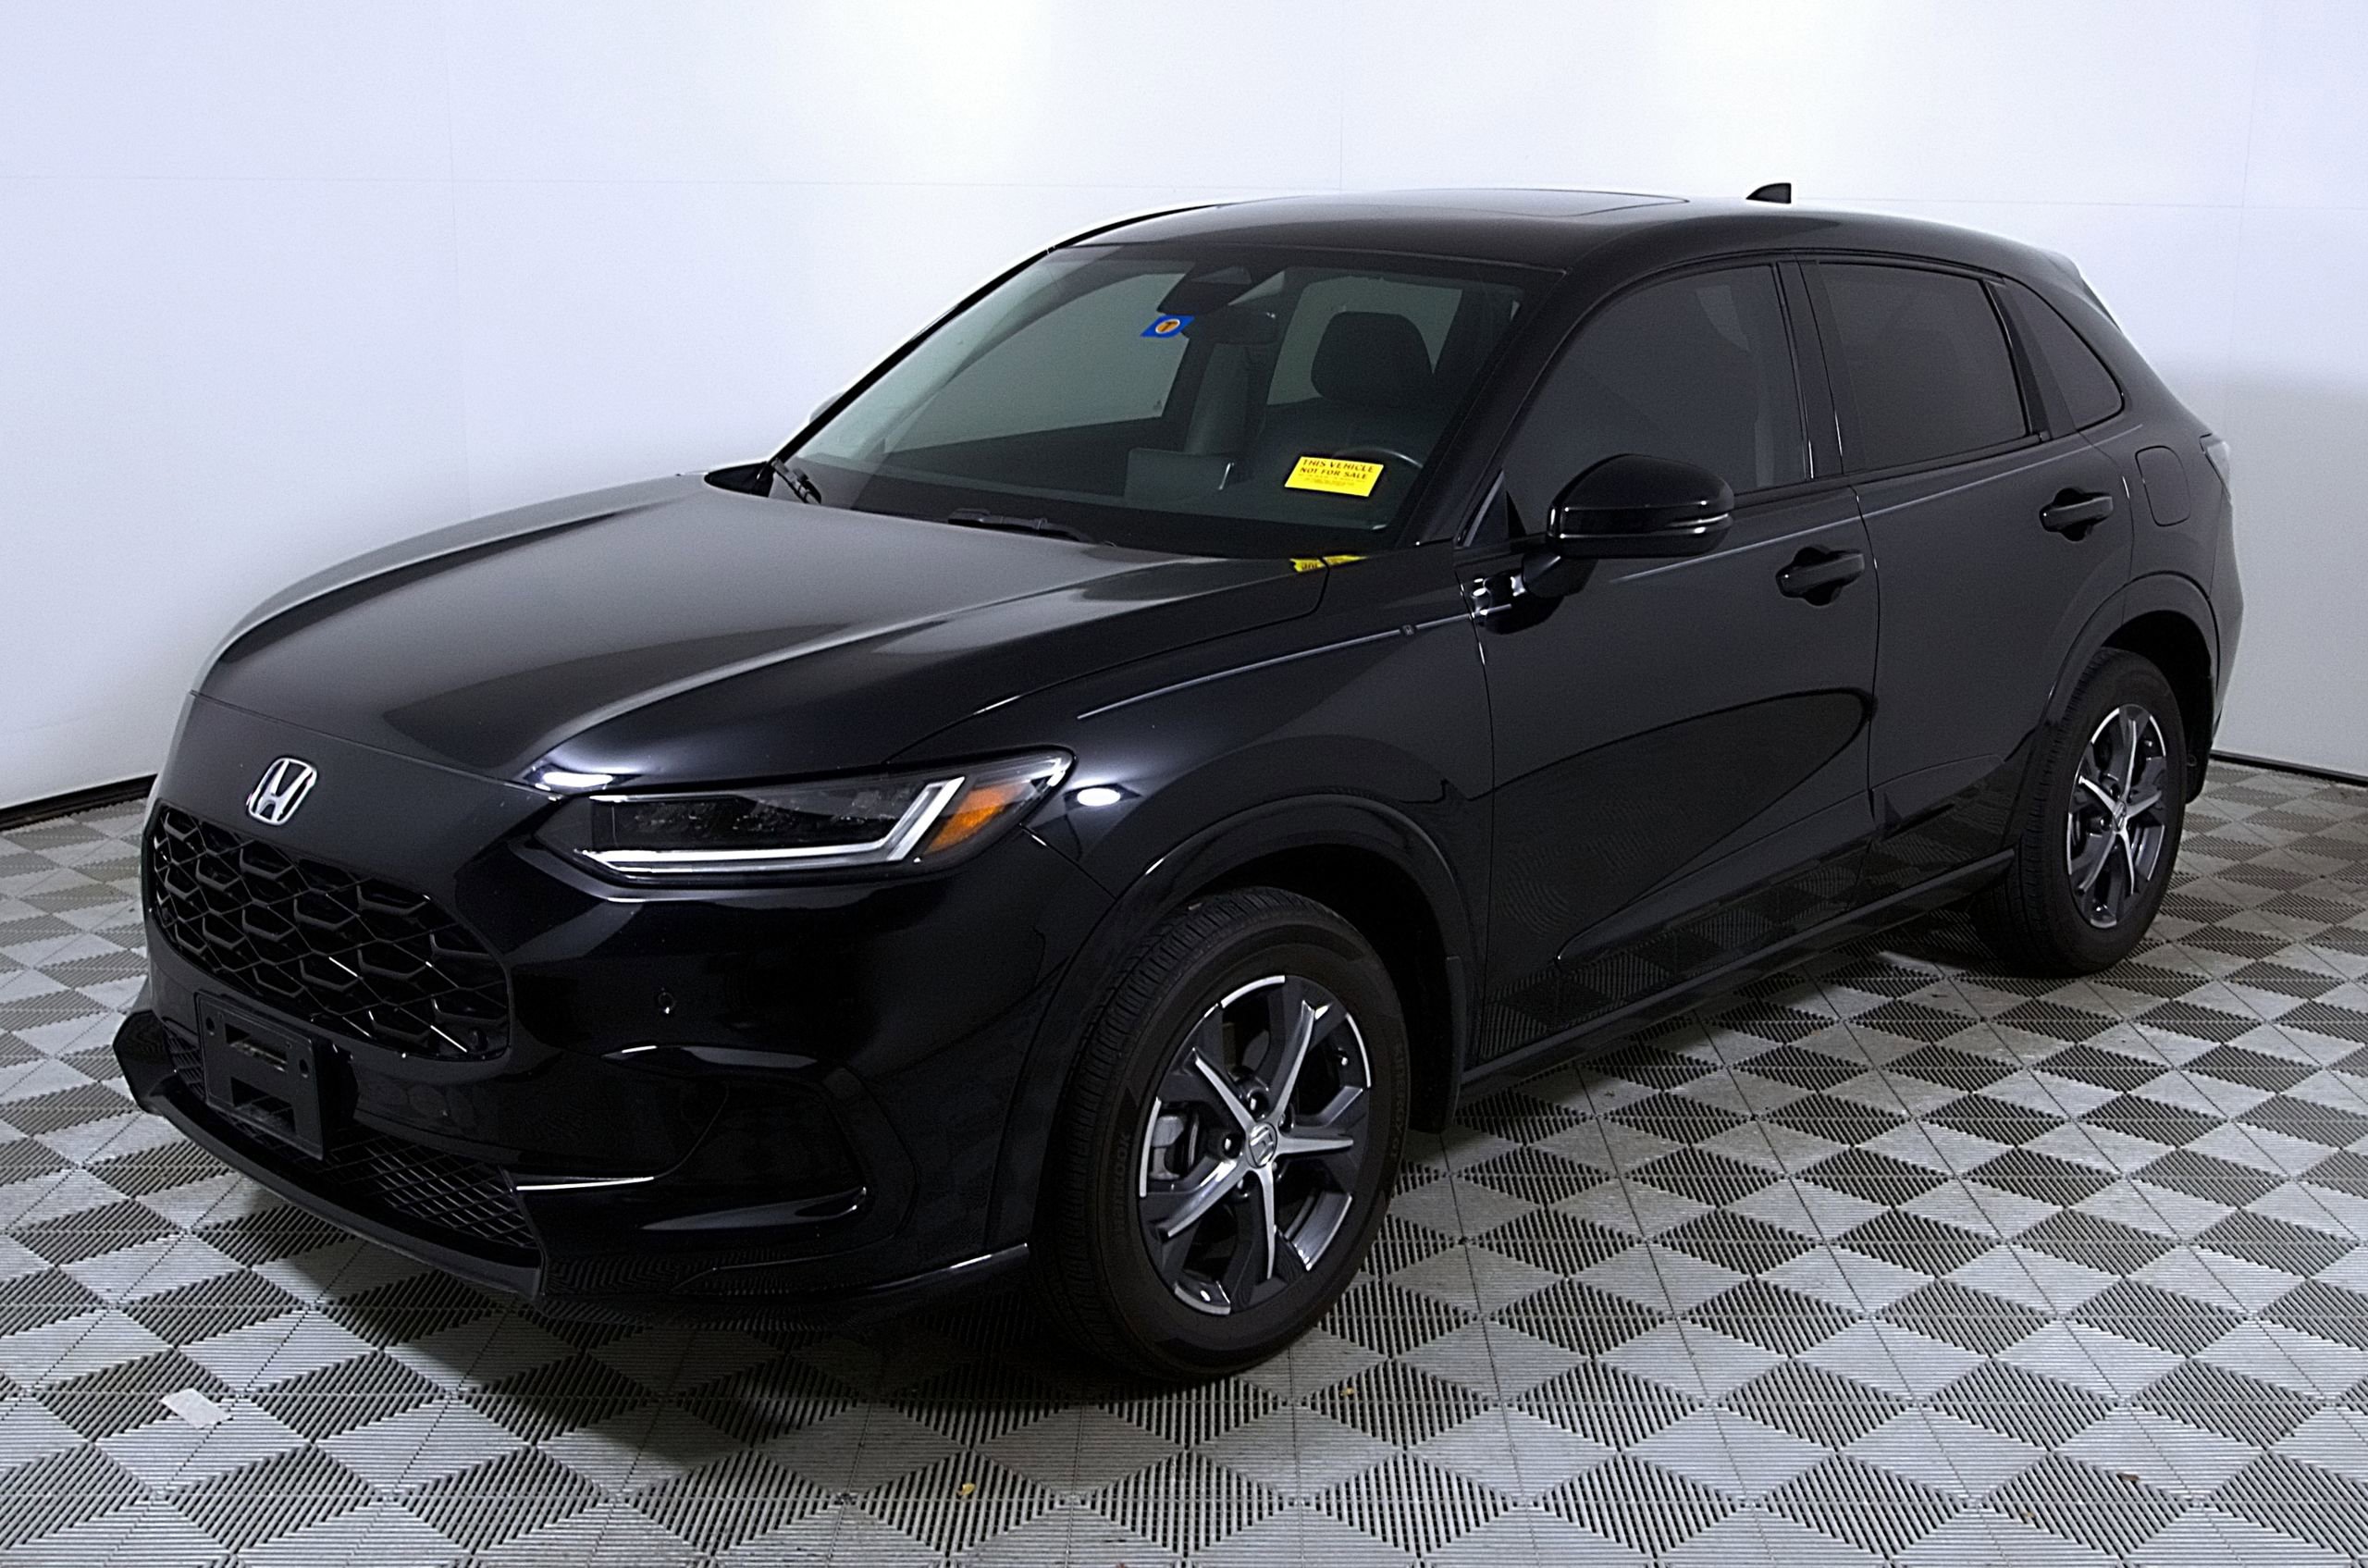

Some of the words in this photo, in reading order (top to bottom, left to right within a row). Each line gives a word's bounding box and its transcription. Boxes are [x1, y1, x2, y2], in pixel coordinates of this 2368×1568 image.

[1300, 466, 1318, 475] NOT
[1321, 468, 1341, 476] FOR
[1344, 471, 1368, 480] SALE
[1302, 459, 1326, 467] THIS
[1329, 462, 1375, 473] VEHICLE
